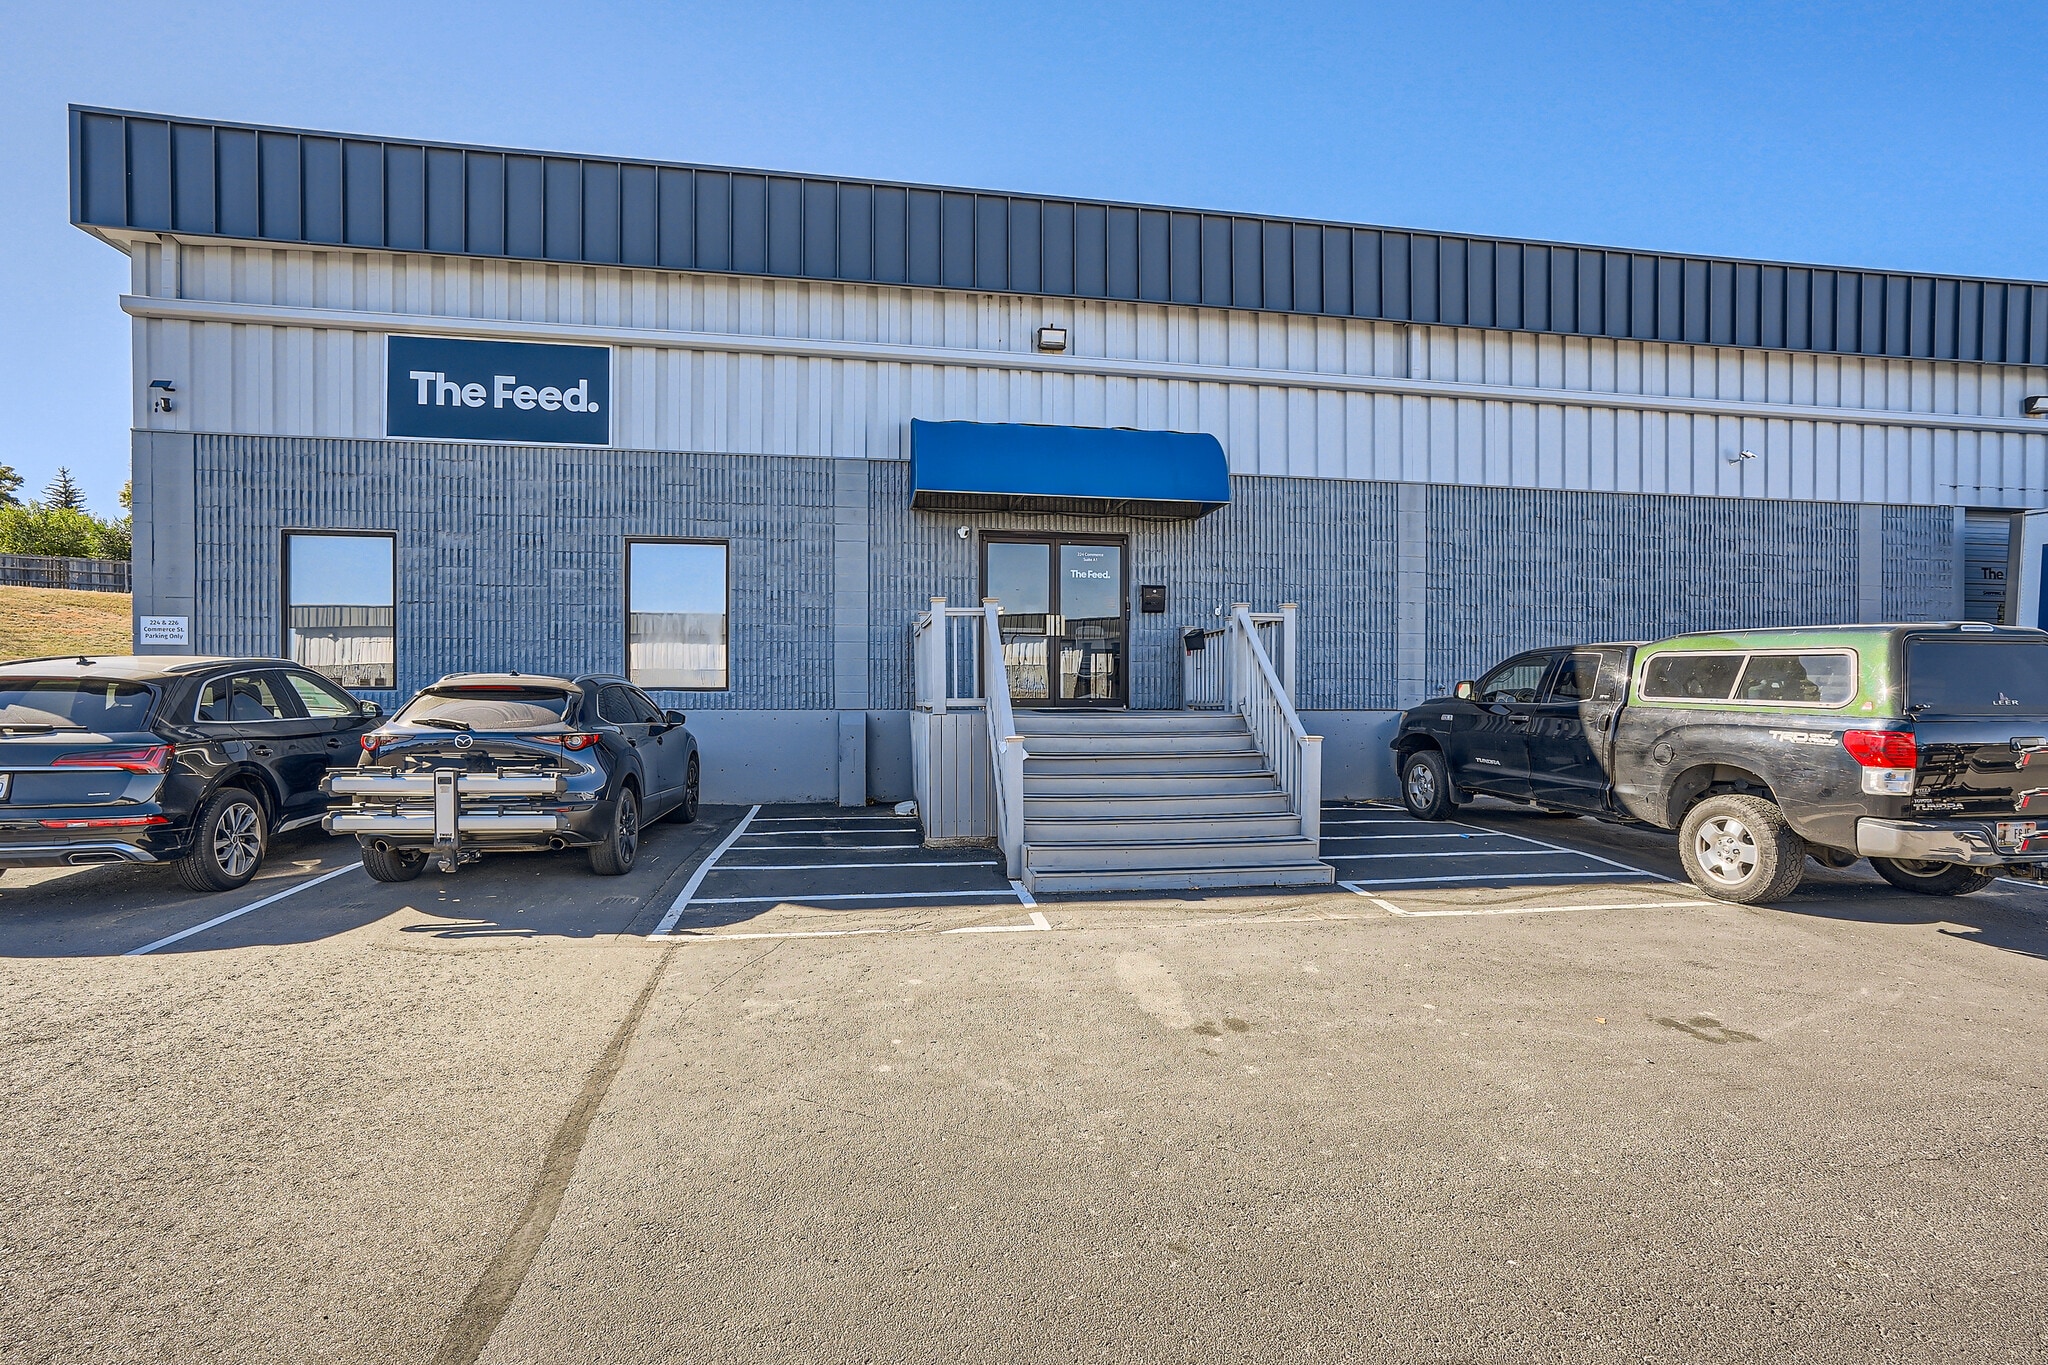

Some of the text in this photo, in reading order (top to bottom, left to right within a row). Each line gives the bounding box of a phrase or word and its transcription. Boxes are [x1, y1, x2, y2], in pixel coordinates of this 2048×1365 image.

[409, 370, 600, 413] The Feed.
[1070, 569, 1111, 579] The Feed.
[1981, 567, 2004, 580] The
[1768, 729, 1809, 744] TRD
[1475, 757, 1501, 766] TUNDRA
[1913, 802, 1965, 811] TUNDRA
